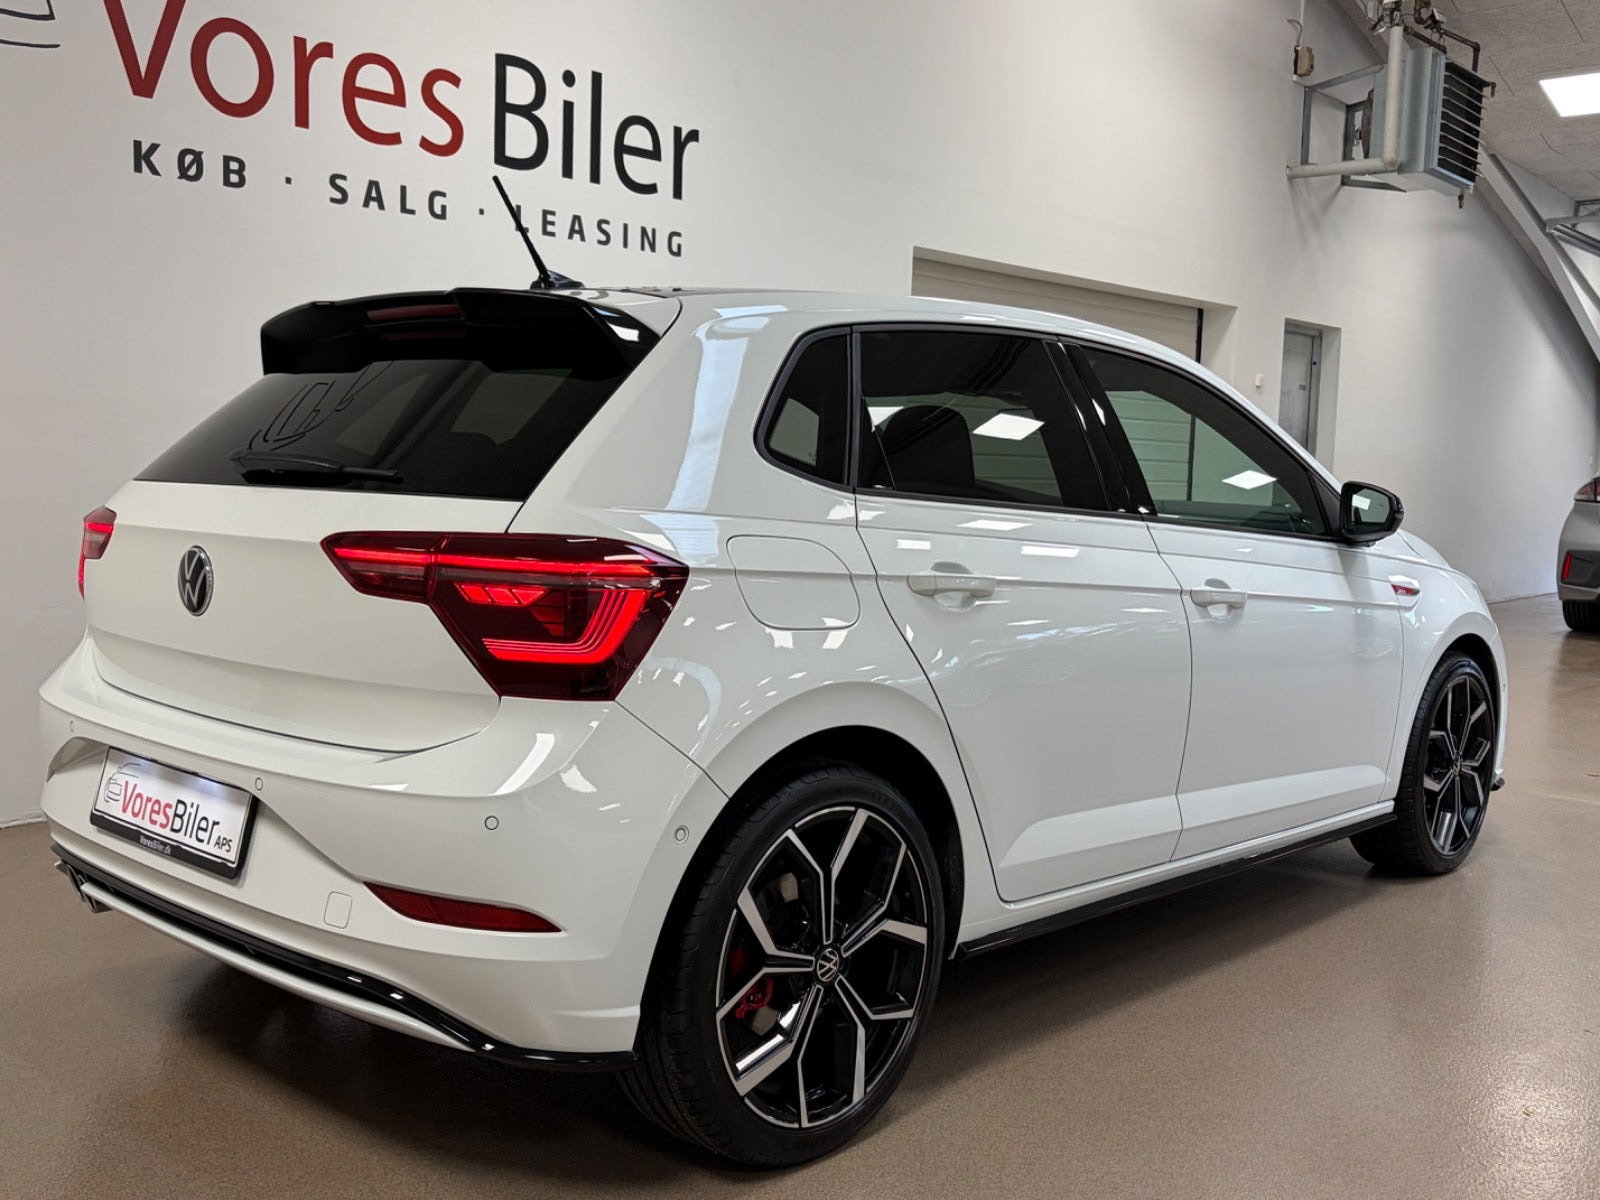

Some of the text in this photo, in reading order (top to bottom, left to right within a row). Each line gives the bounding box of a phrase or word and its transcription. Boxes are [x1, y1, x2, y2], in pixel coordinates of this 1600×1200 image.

[132, 139, 683, 258] KØB SALG LEASING
[213, 835, 233, 853] APS
